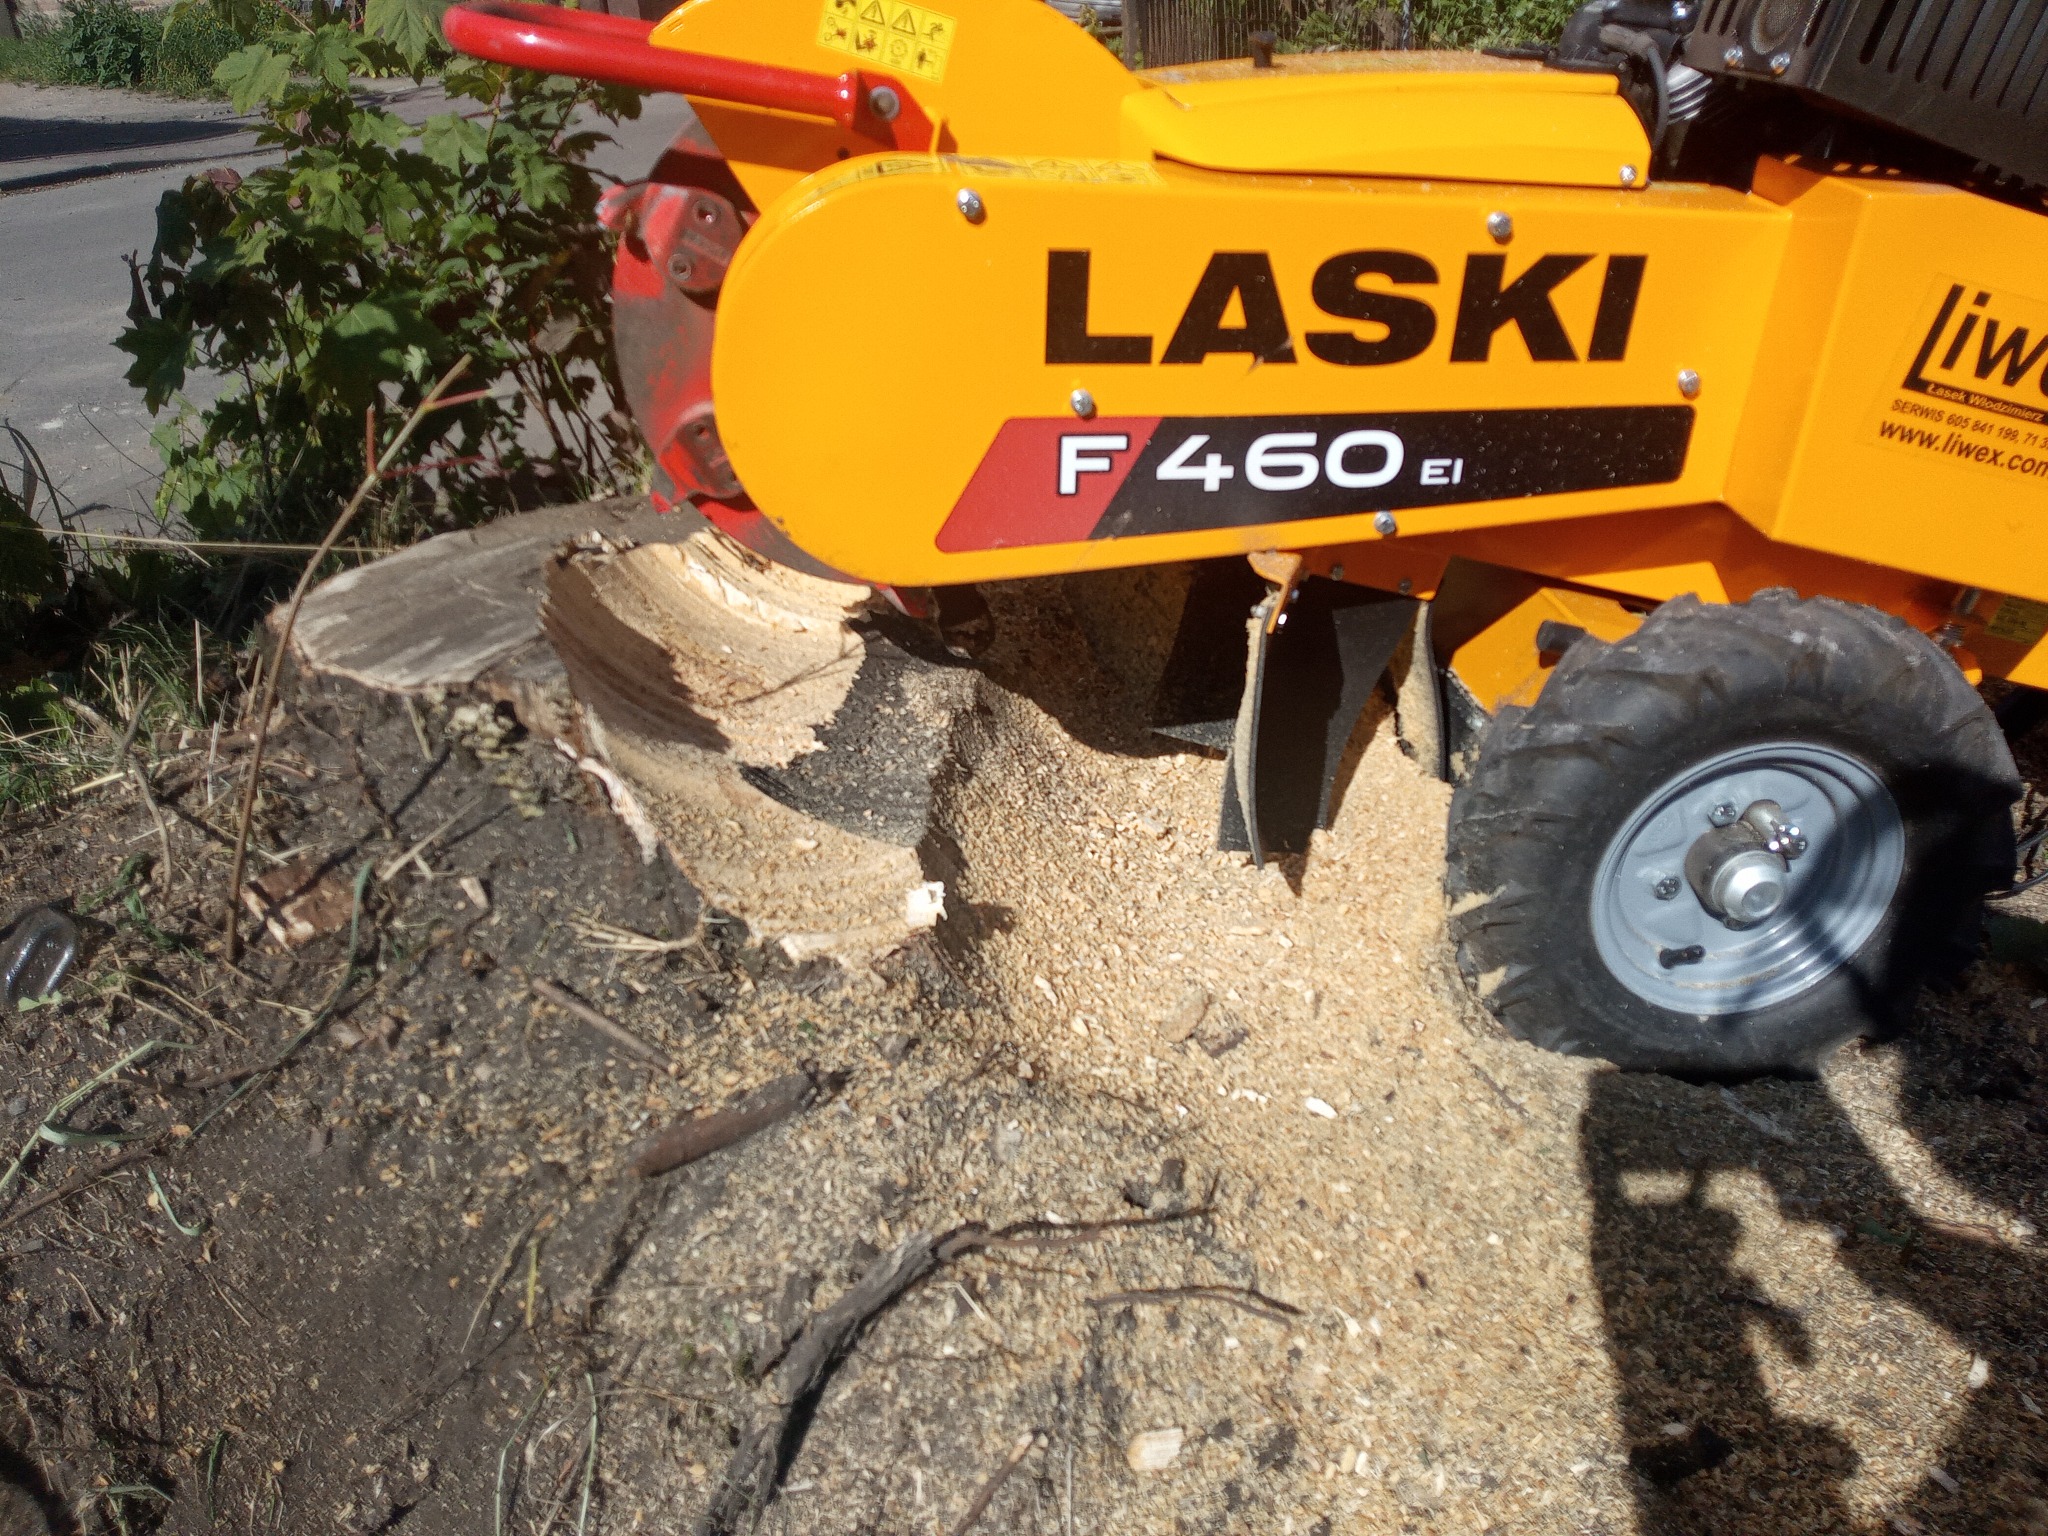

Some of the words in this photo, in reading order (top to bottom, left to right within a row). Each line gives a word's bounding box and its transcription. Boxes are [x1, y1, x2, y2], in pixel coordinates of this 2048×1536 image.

[1045, 247, 1648, 367] LASKI
[1902, 283, 2048, 398] Liw
[1057, 433, 1130, 496] F
[1156, 429, 1405, 492] 460
[1420, 457, 1465, 486] EI
[1892, 399, 1945, 422] SERWIS
[1947, 413, 1971, 429] 605
[1972, 420, 1994, 435] 841
[2023, 432, 2040, 446] 71
